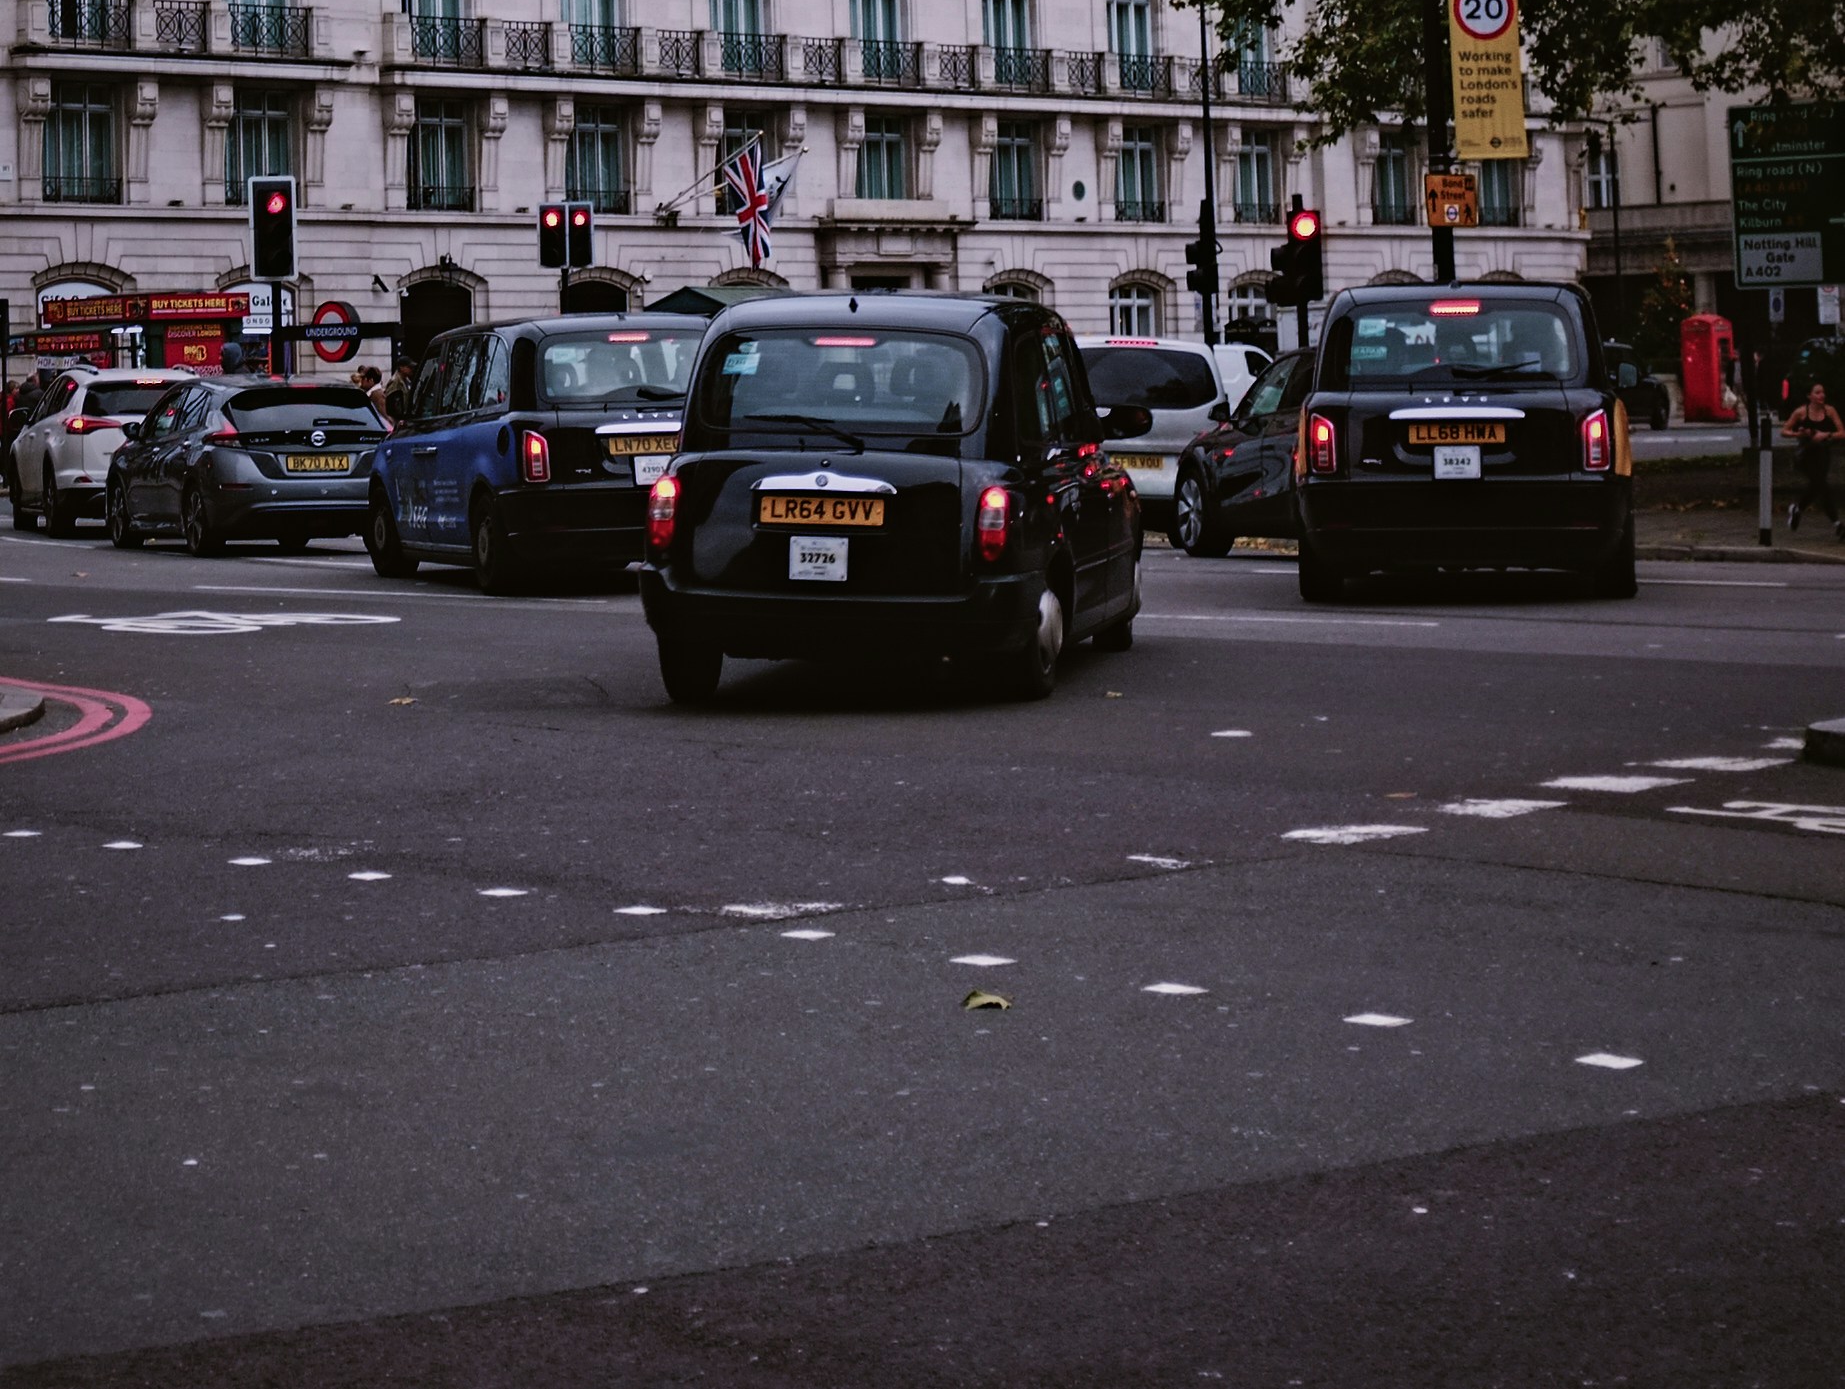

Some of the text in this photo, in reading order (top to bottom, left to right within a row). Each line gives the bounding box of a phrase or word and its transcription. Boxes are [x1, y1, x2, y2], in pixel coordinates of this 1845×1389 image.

[1458, 51, 1512, 63] Working
[1459, 65, 1511, 76] to make
[1460, 80, 1517, 90] London's
[1461, 94, 1496, 104] roads
[1461, 108, 1494, 118] safer
[1750, 110, 1776, 123] Ring
[1737, 162, 1822, 179] Ring road (N)
[1440, 190, 1466, 200] Street
[1738, 198, 1787, 211] The City
[1740, 217, 1782, 228] Kilburn
[1744, 237, 1817, 251] Notting Hill
[1766, 253, 1795, 263] Gate
[1745, 266, 1781, 277] A402
[152, 298, 227, 309] BUY TICKETS HERE
[306, 326, 358, 337] UNDERGROUND
[1416, 425, 1497, 440] LL68 HWA
[614, 438, 651, 452] LN70
[293, 457, 345, 468] BK70 ATX
[770, 499, 874, 521] LR64 GVV
[800, 553, 836, 564] 32726
